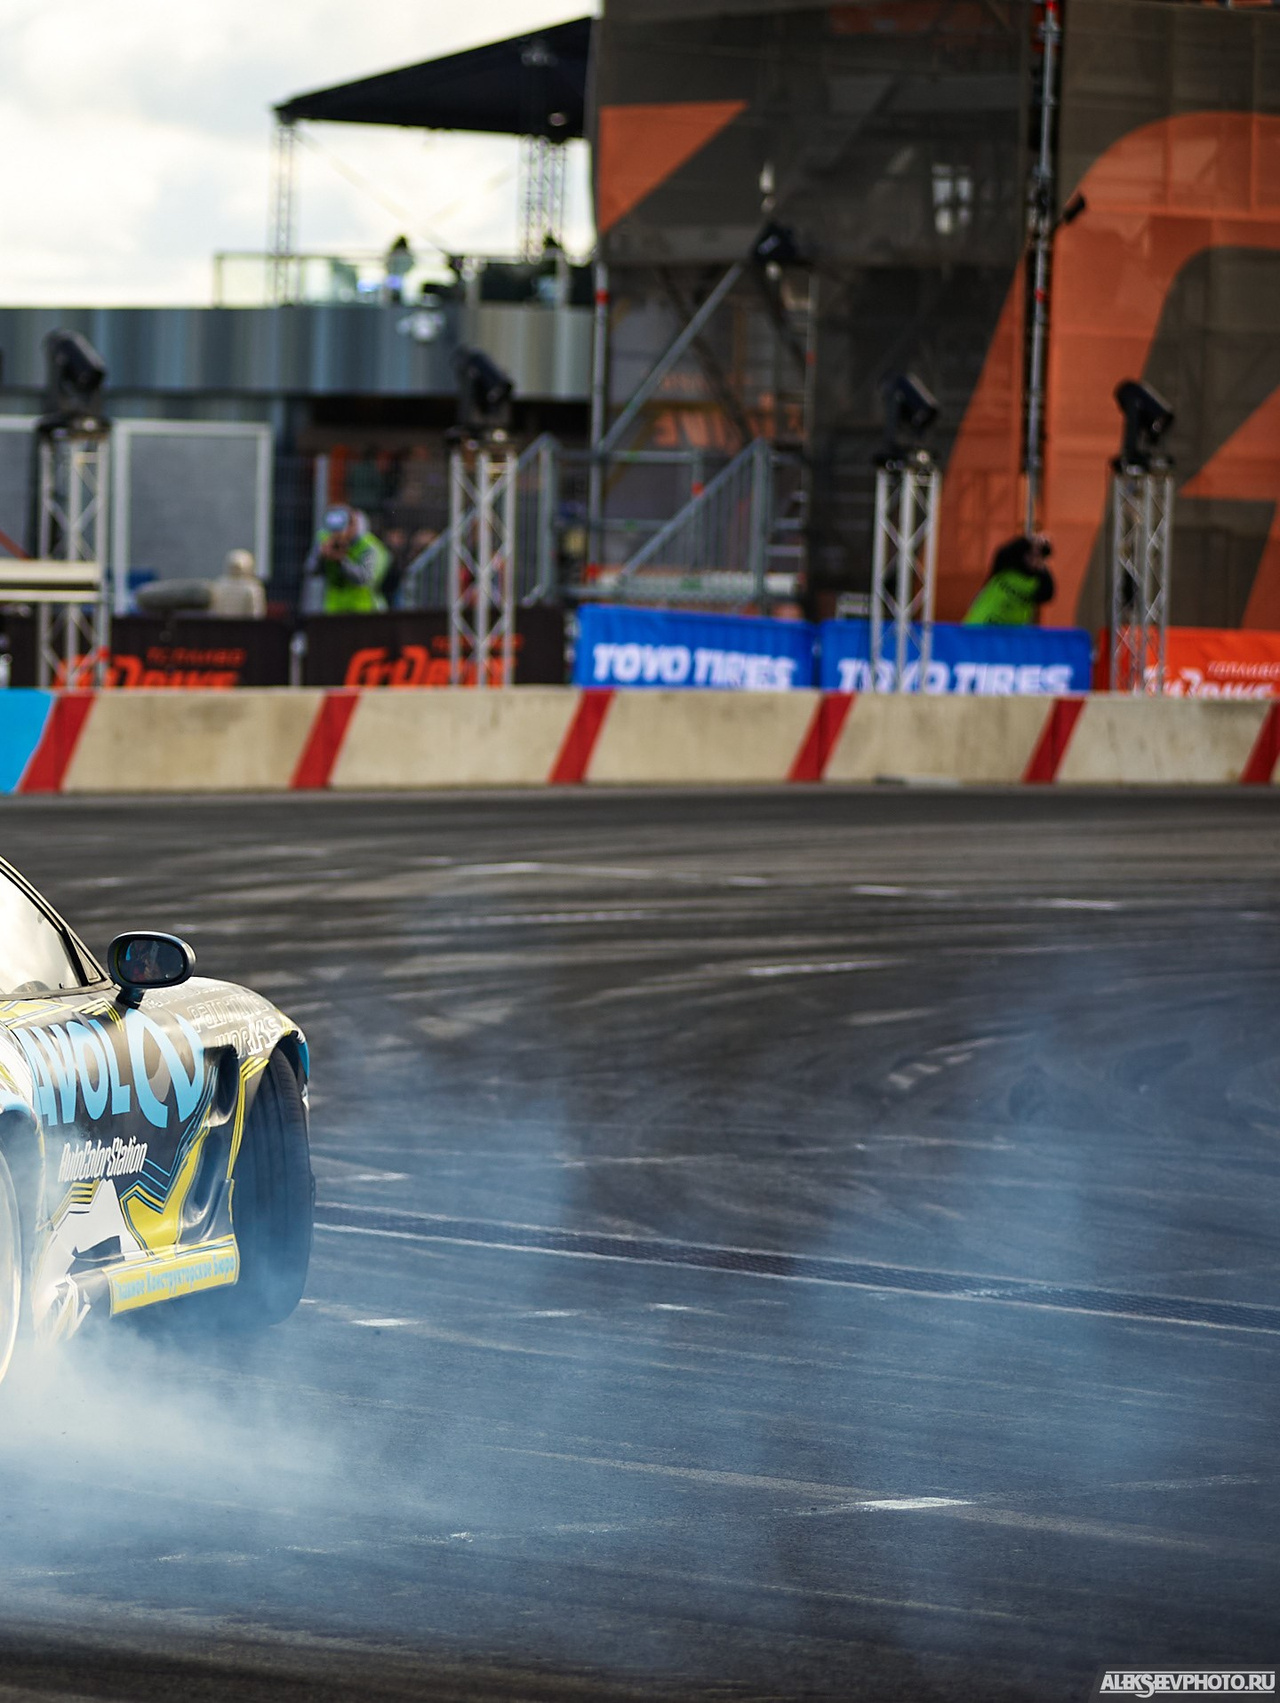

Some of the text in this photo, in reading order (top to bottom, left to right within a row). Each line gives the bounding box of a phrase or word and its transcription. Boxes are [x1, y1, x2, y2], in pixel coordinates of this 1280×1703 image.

[594, 643, 796, 690] TOYO TIRES
[953, 662, 1074, 695] TIRES
[14, 1019, 131, 1127] AVOL
[58, 1135, 148, 1182] AutoColorStation
